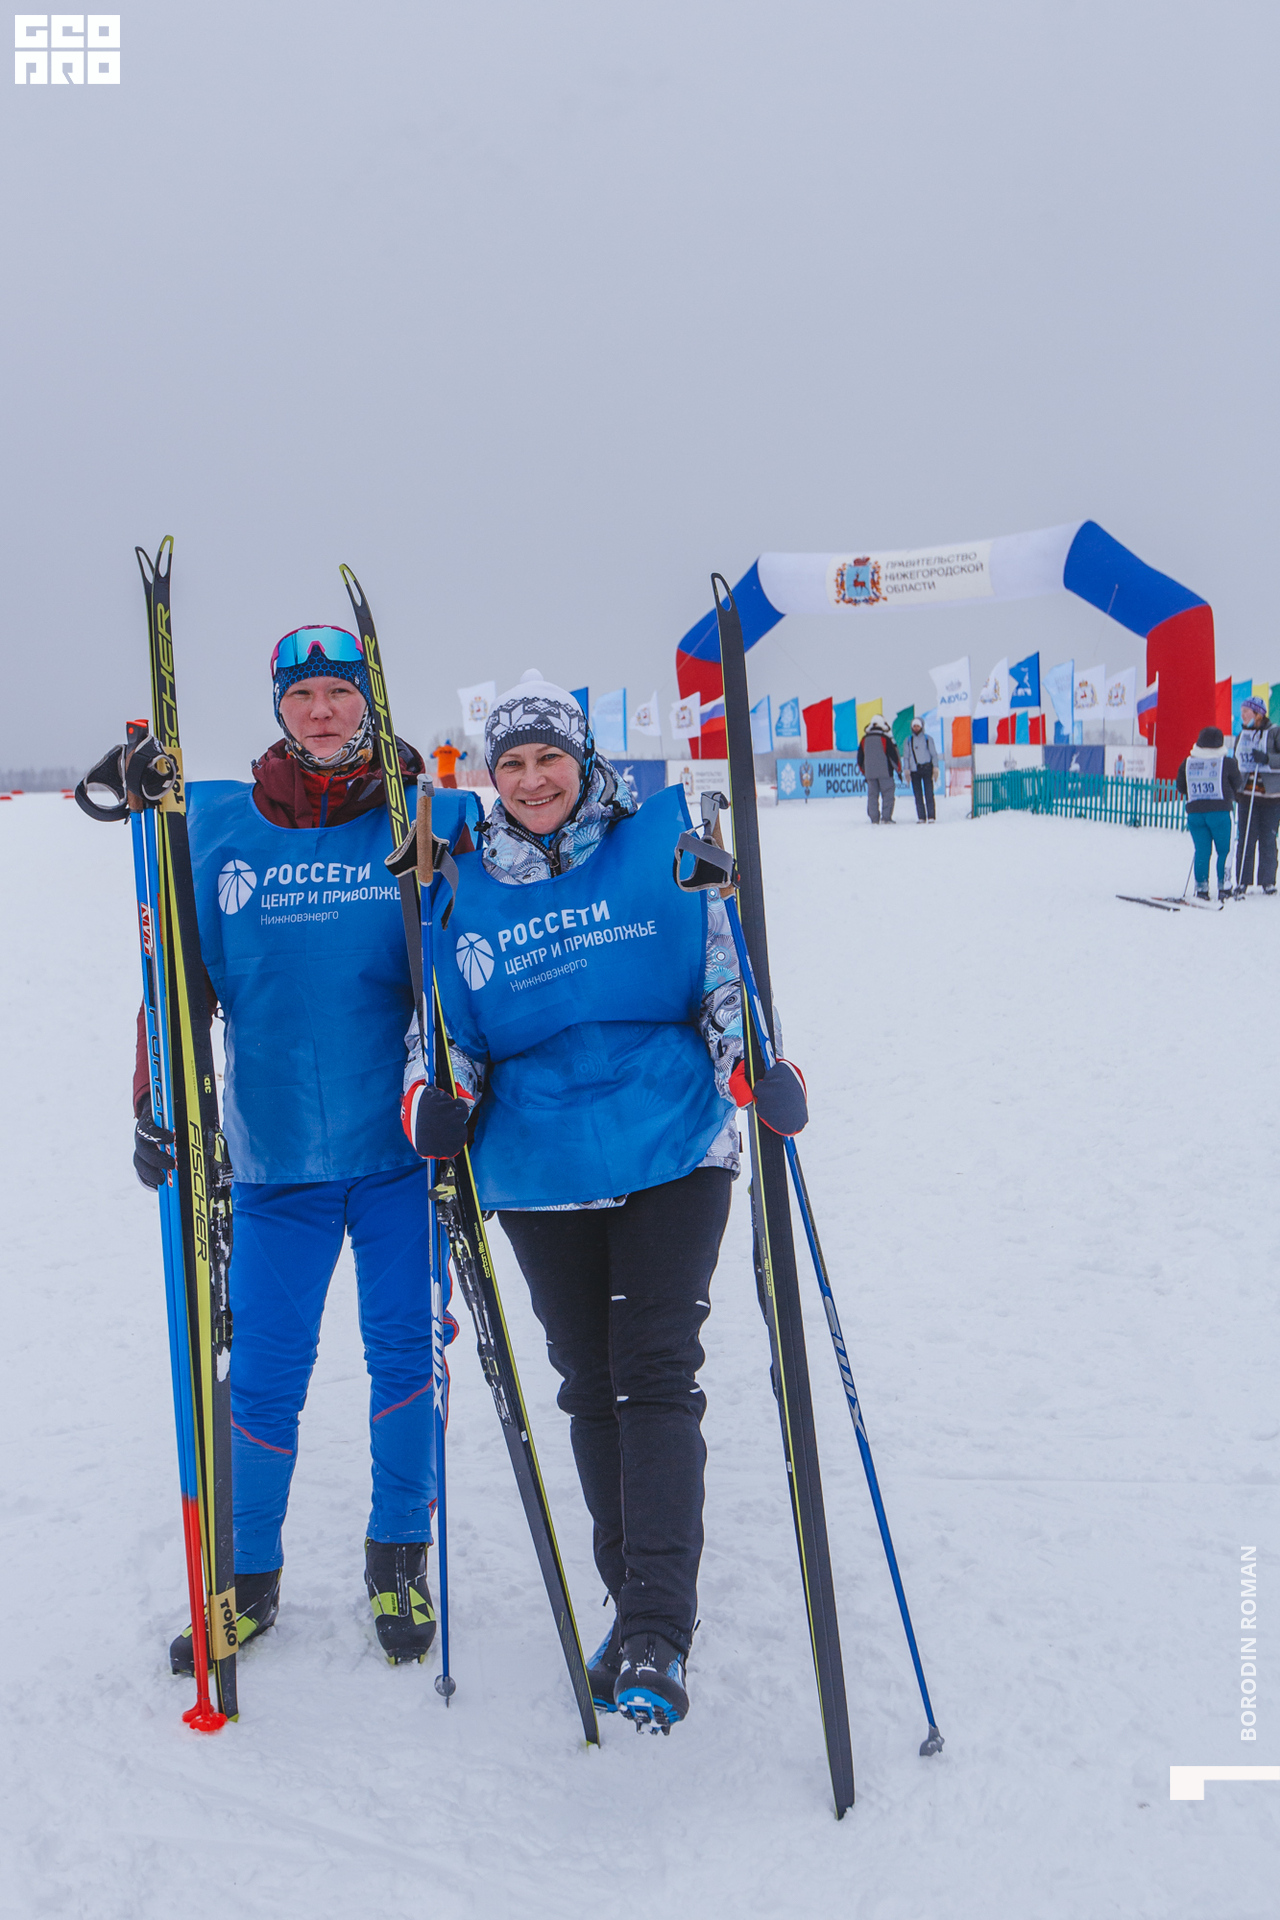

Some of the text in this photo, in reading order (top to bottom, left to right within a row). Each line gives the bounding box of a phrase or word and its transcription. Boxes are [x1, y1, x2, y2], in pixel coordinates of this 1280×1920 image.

[885, 552, 978, 570] ПРАВИТЕЛЬСТВО
[885, 562, 984, 581] НИЖЕГОРОДСКОЙ
[885, 581, 936, 594] ОБЛАСТИ
[826, 779, 866, 793] РОССИИ
[1191, 782, 1215, 793] 3139
[263, 862, 371, 886] РОССЕТИ
[261, 886, 401, 910] ЦЕНТР И ПРИВОЛЖЬ
[260, 911, 339, 926] Нижновэнерго
[498, 900, 611, 952] РОССЕТИ
[504, 920, 658, 976] ЦЕНТР И ПРИВОЛЖЬЕ
[509, 958, 588, 993] Нижновэнерго
[188, 1119, 208, 1262] FISCHER
[431, 1275, 444, 1421] SWIX
[824, 1295, 868, 1443] SWIX
[220, 1598, 237, 1647] TOKO
